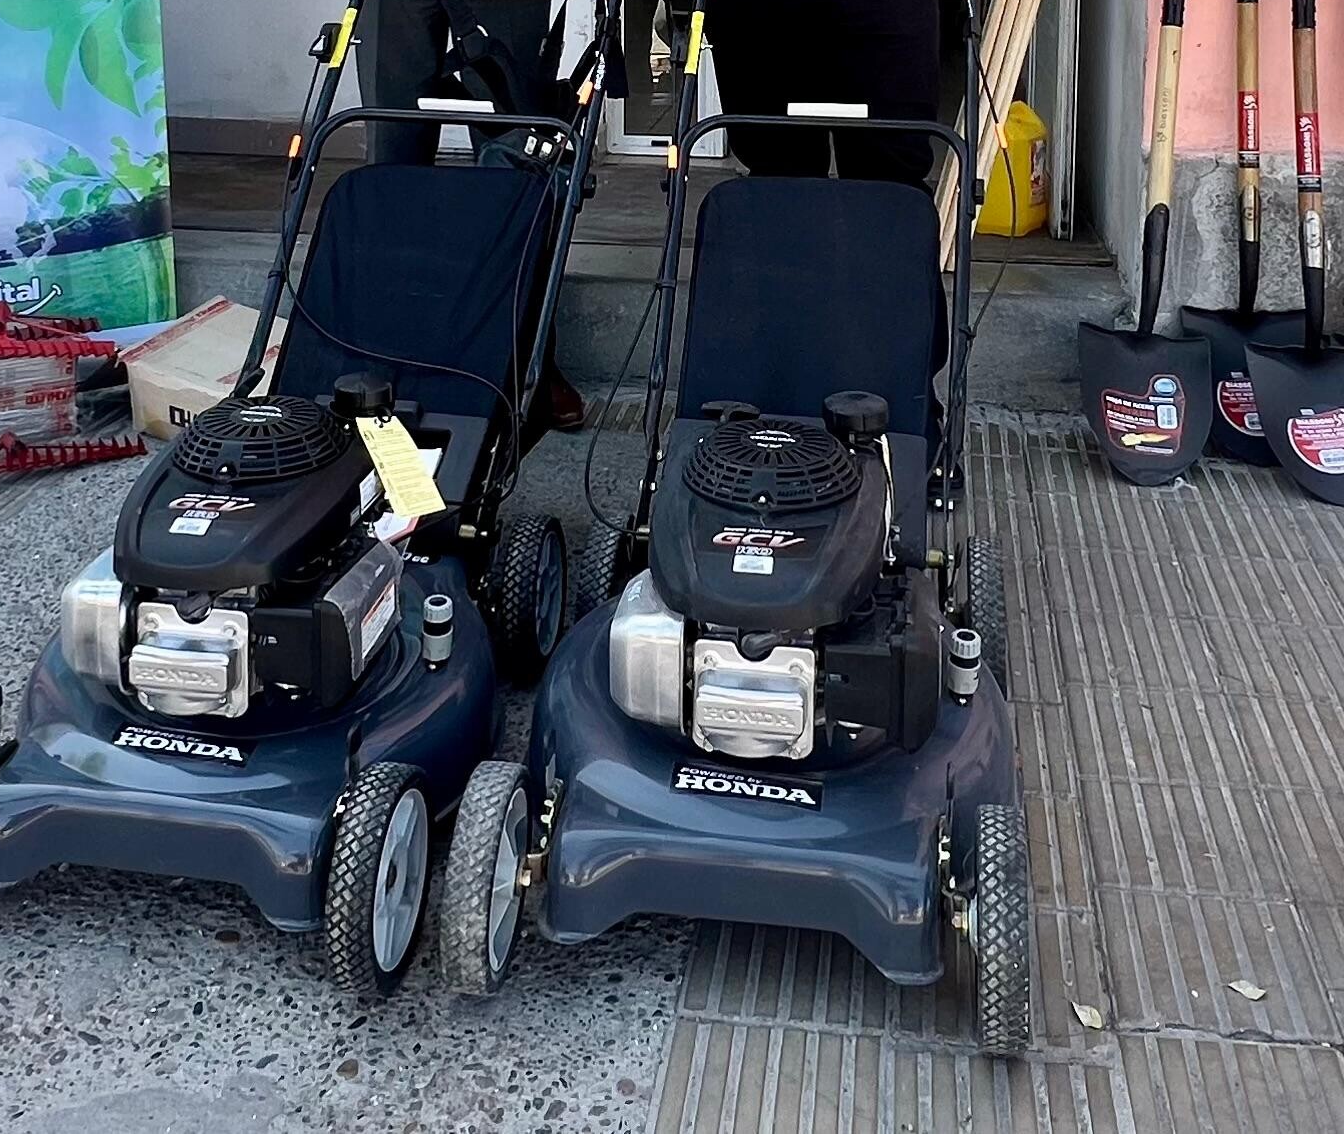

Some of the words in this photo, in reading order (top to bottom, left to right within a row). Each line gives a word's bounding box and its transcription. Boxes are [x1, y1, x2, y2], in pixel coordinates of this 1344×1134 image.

[1247, 109, 1255, 149] BIASSONI
[1303, 132, 1313, 172] BIASSONI
[168, 498, 256, 511] GCV
[712, 531, 806, 547] GCV
[135, 667, 218, 686] HONDA
[703, 706, 795, 728] HONDA
[114, 732, 243, 761] HONDA
[680, 766, 745, 781] POWERED
[675, 773, 816, 805] HONDA
